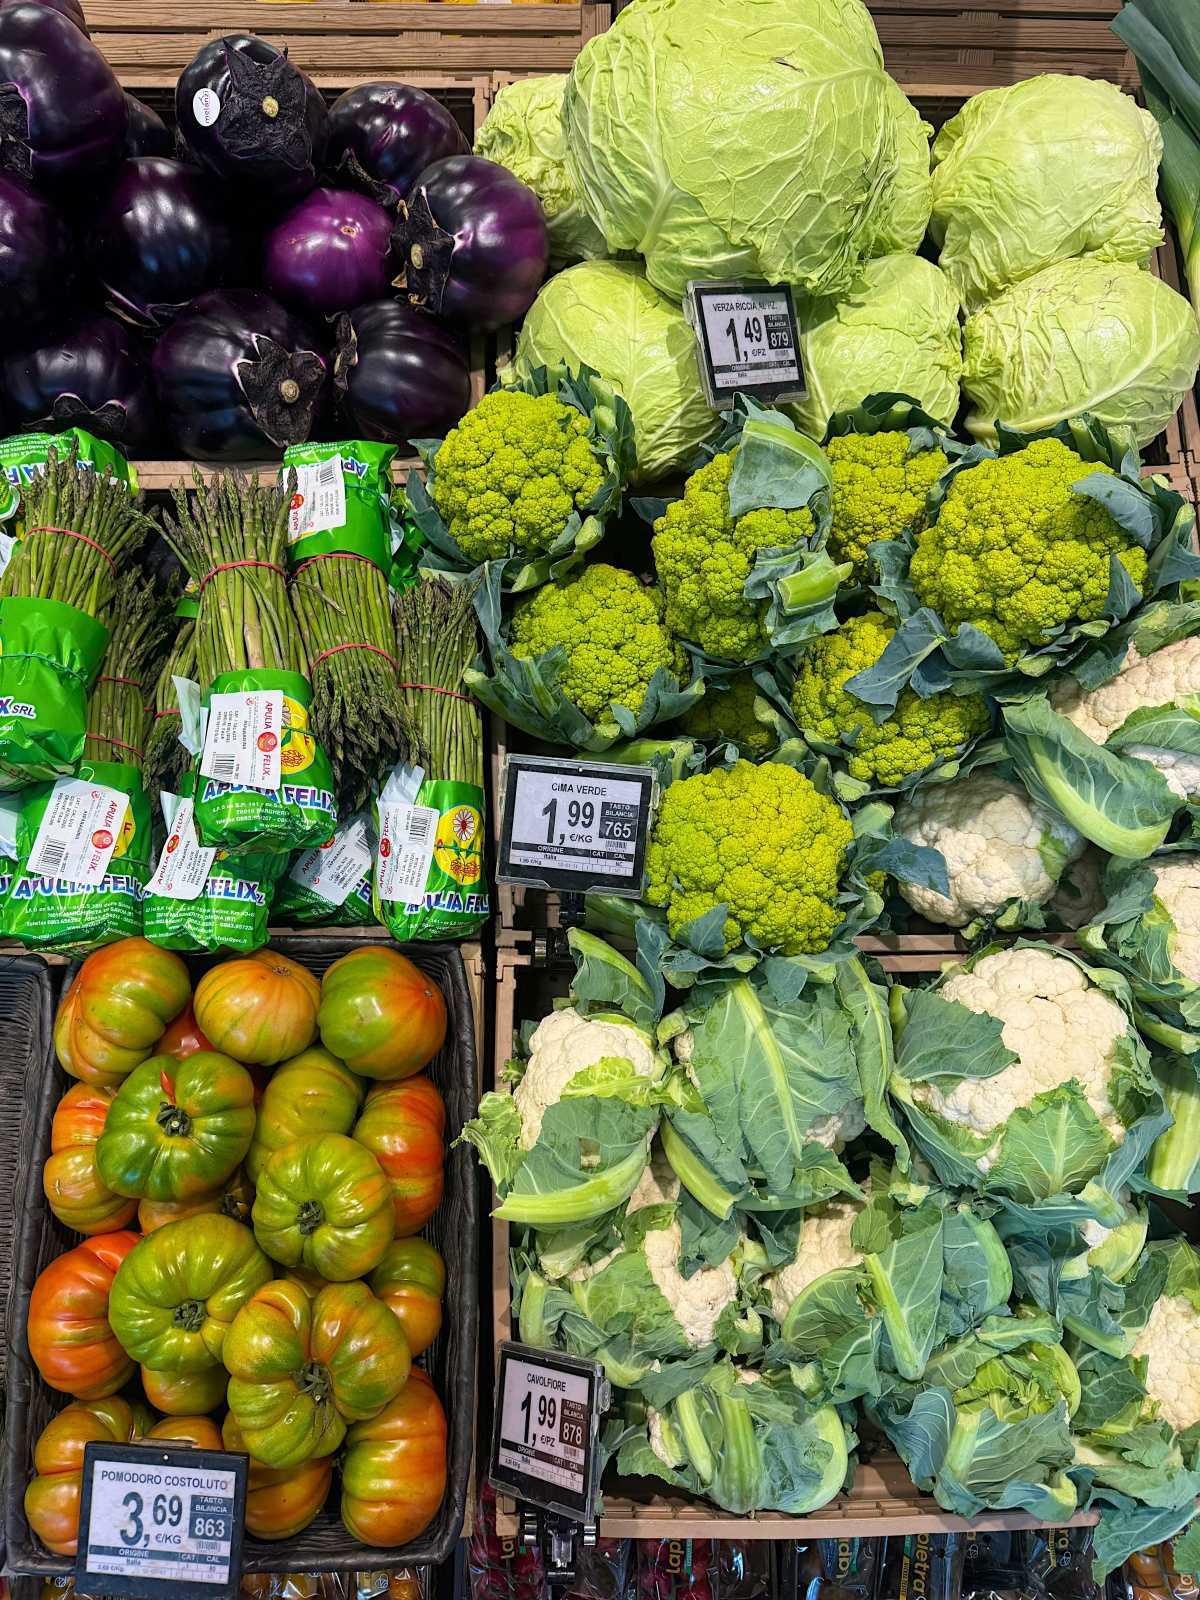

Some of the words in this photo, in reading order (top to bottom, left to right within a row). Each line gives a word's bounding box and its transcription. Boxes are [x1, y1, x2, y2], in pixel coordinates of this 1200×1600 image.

[713, 302, 734, 312] VERZA
[736, 301, 757, 311] RICCIA
[726, 317, 762, 362] 1,49
[770, 332, 789, 347] 879
[11, 704, 35, 717] SRL
[263, 702, 273, 730] APULIA
[262, 754, 272, 776] FELIX
[551, 782, 574, 794] CIMA
[576, 785, 607, 796] VERDE
[105, 801, 119, 828] APULIA
[176, 812, 186, 833] FELIX
[541, 798, 595, 845] 1,99
[605, 809, 634, 818] BILANCIA
[569, 833, 593, 843] €/KG
[604, 821, 632, 839] 765
[89, 850, 102, 872] FELIX
[302, 848, 322, 874] APULIA
[537, 845, 565, 854] ORIGINE
[592, 850, 606, 858] CAT
[614, 853, 627, 861] CAL
[157, 856, 170, 885] APULIA
[379, 860, 388, 888] APULIA
[527, 1372, 567, 1392] CAVOLFIORE
[521, 1391, 557, 1447] 1,99
[562, 1422, 582, 1444] 878
[101, 1470, 162, 1485] POMODORO
[164, 1475, 228, 1490] COSTOLUTO
[195, 1504, 228, 1513] BILANCIA
[199, 1496, 224, 1504] TASTO
[119, 1491, 183, 1547] 3,69
[194, 1518, 225, 1538] 863
[155, 1533, 182, 1545] €/KG
[119, 1549, 149, 1558] ORIGINE
[206, 1555, 220, 1563] CAL
